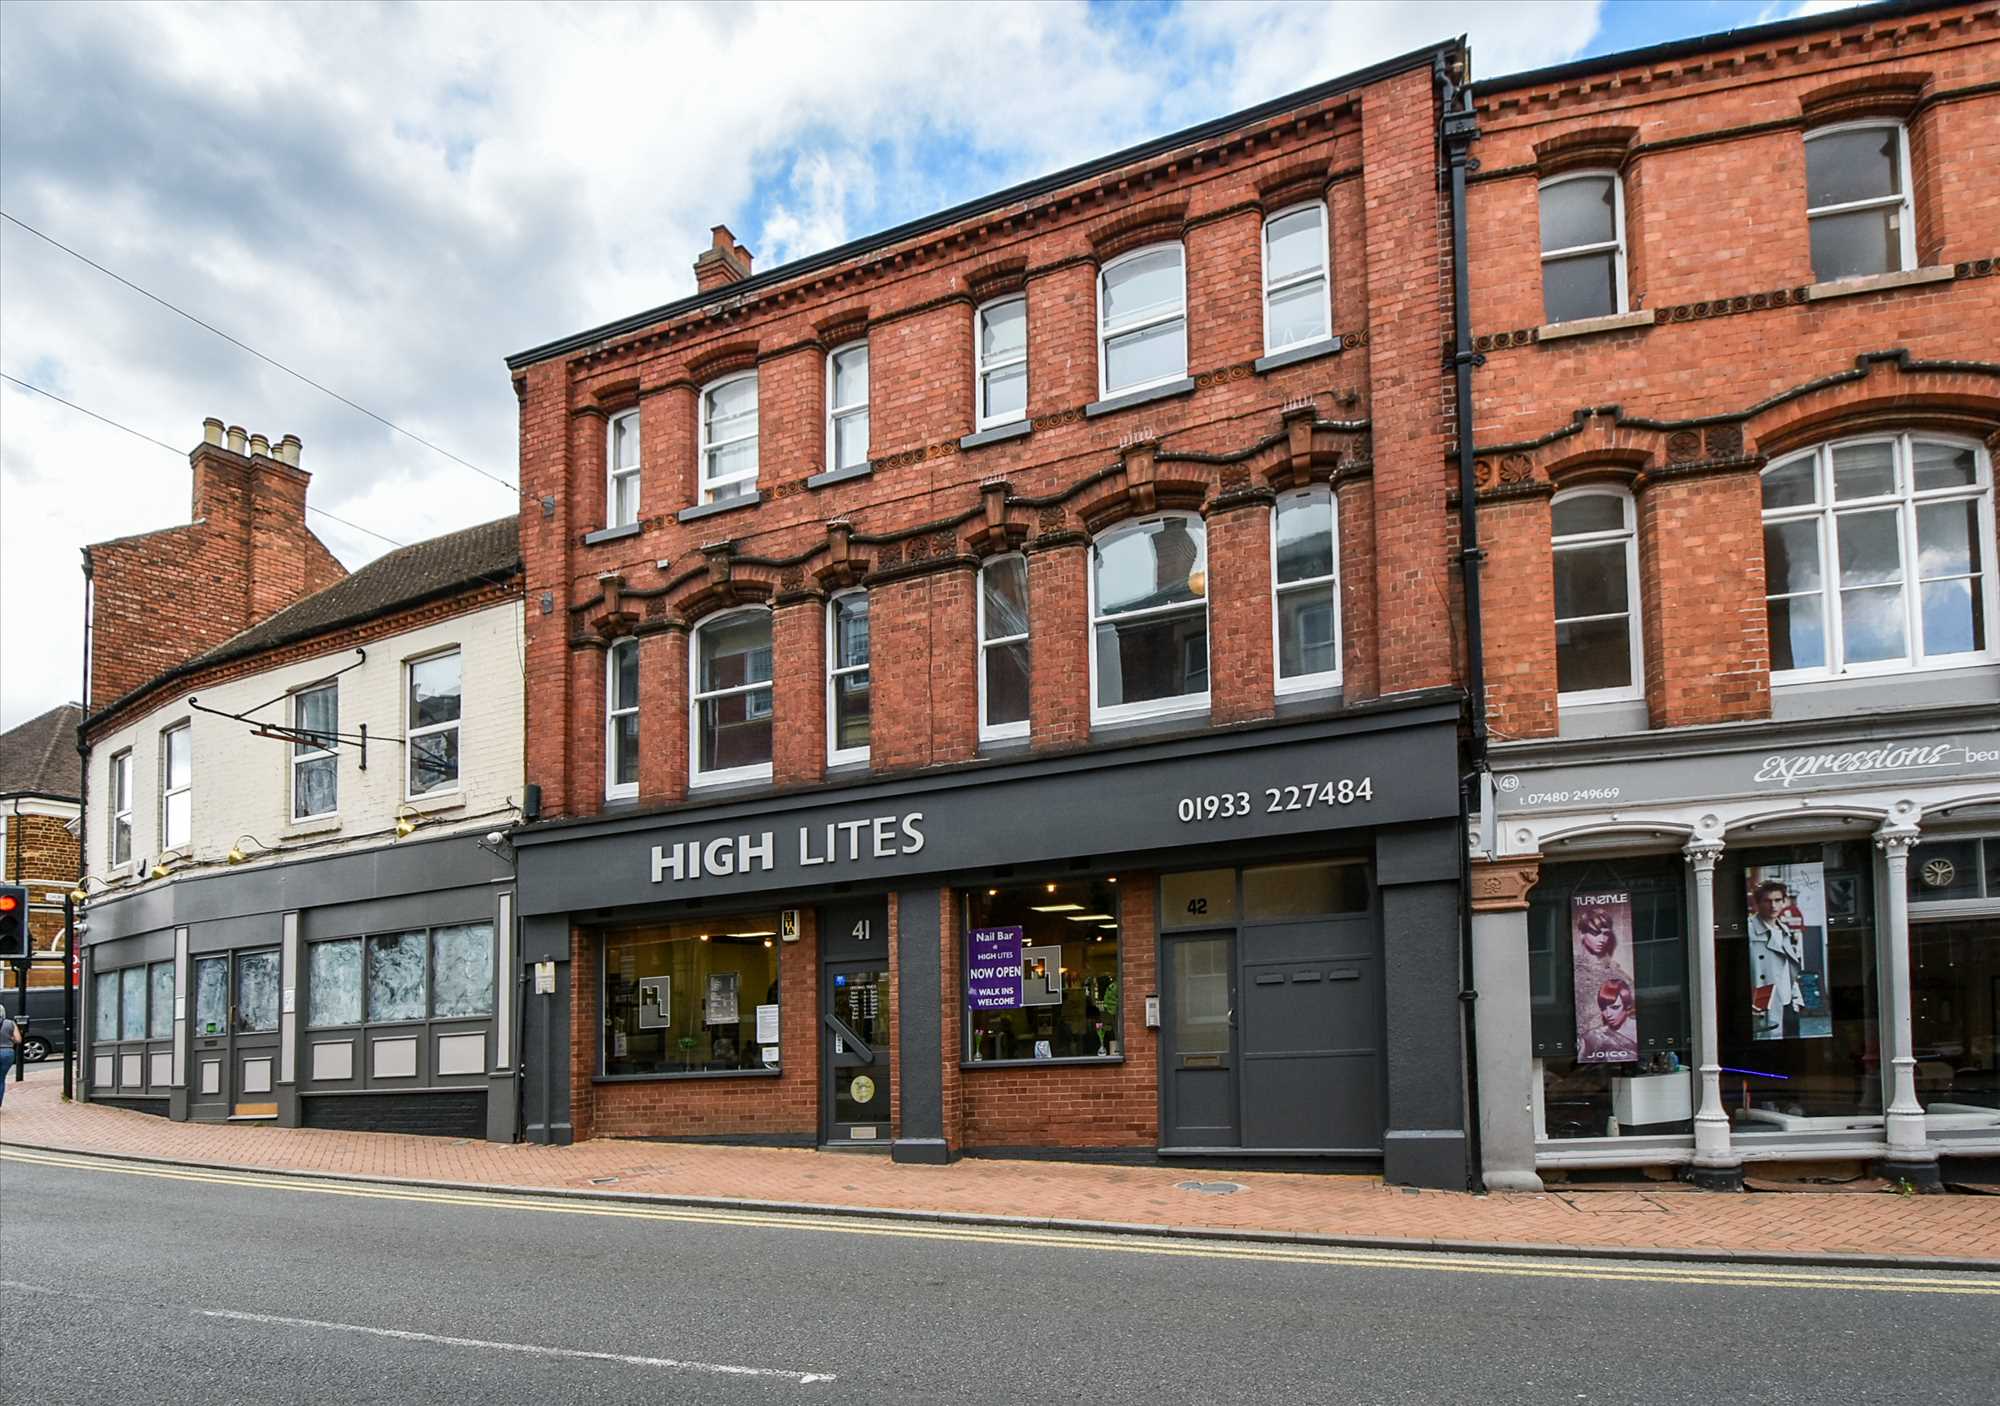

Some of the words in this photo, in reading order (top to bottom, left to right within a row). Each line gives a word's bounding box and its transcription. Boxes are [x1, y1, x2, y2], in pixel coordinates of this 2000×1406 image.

[1966, 747, 1999, 763] bea
[1502, 778, 1516, 789] 43
[1178, 791, 1250, 822] 01933
[1265, 777, 1373, 813] 227484
[1528, 791, 1569, 805] 07480
[1573, 787, 1620, 801] 249669
[651, 831, 774, 883] HIGH
[800, 812, 925, 866] LITES
[1187, 898, 1208, 915] 42
[852, 920, 870, 940] 41
[976, 932, 995, 942] Nail
[997, 931, 1014, 941] Bar
[977, 952, 996, 960] HIGH
[997, 951, 1013, 959] LITES
[970, 967, 994, 980] NOW
[996, 966, 1021, 978] OPEN
[978, 987, 1000, 996] WALK
[1001, 986, 1014, 995] INS
[977, 997, 1015, 1006] WELCOME
[1587, 1050, 1628, 1059] JOICO
